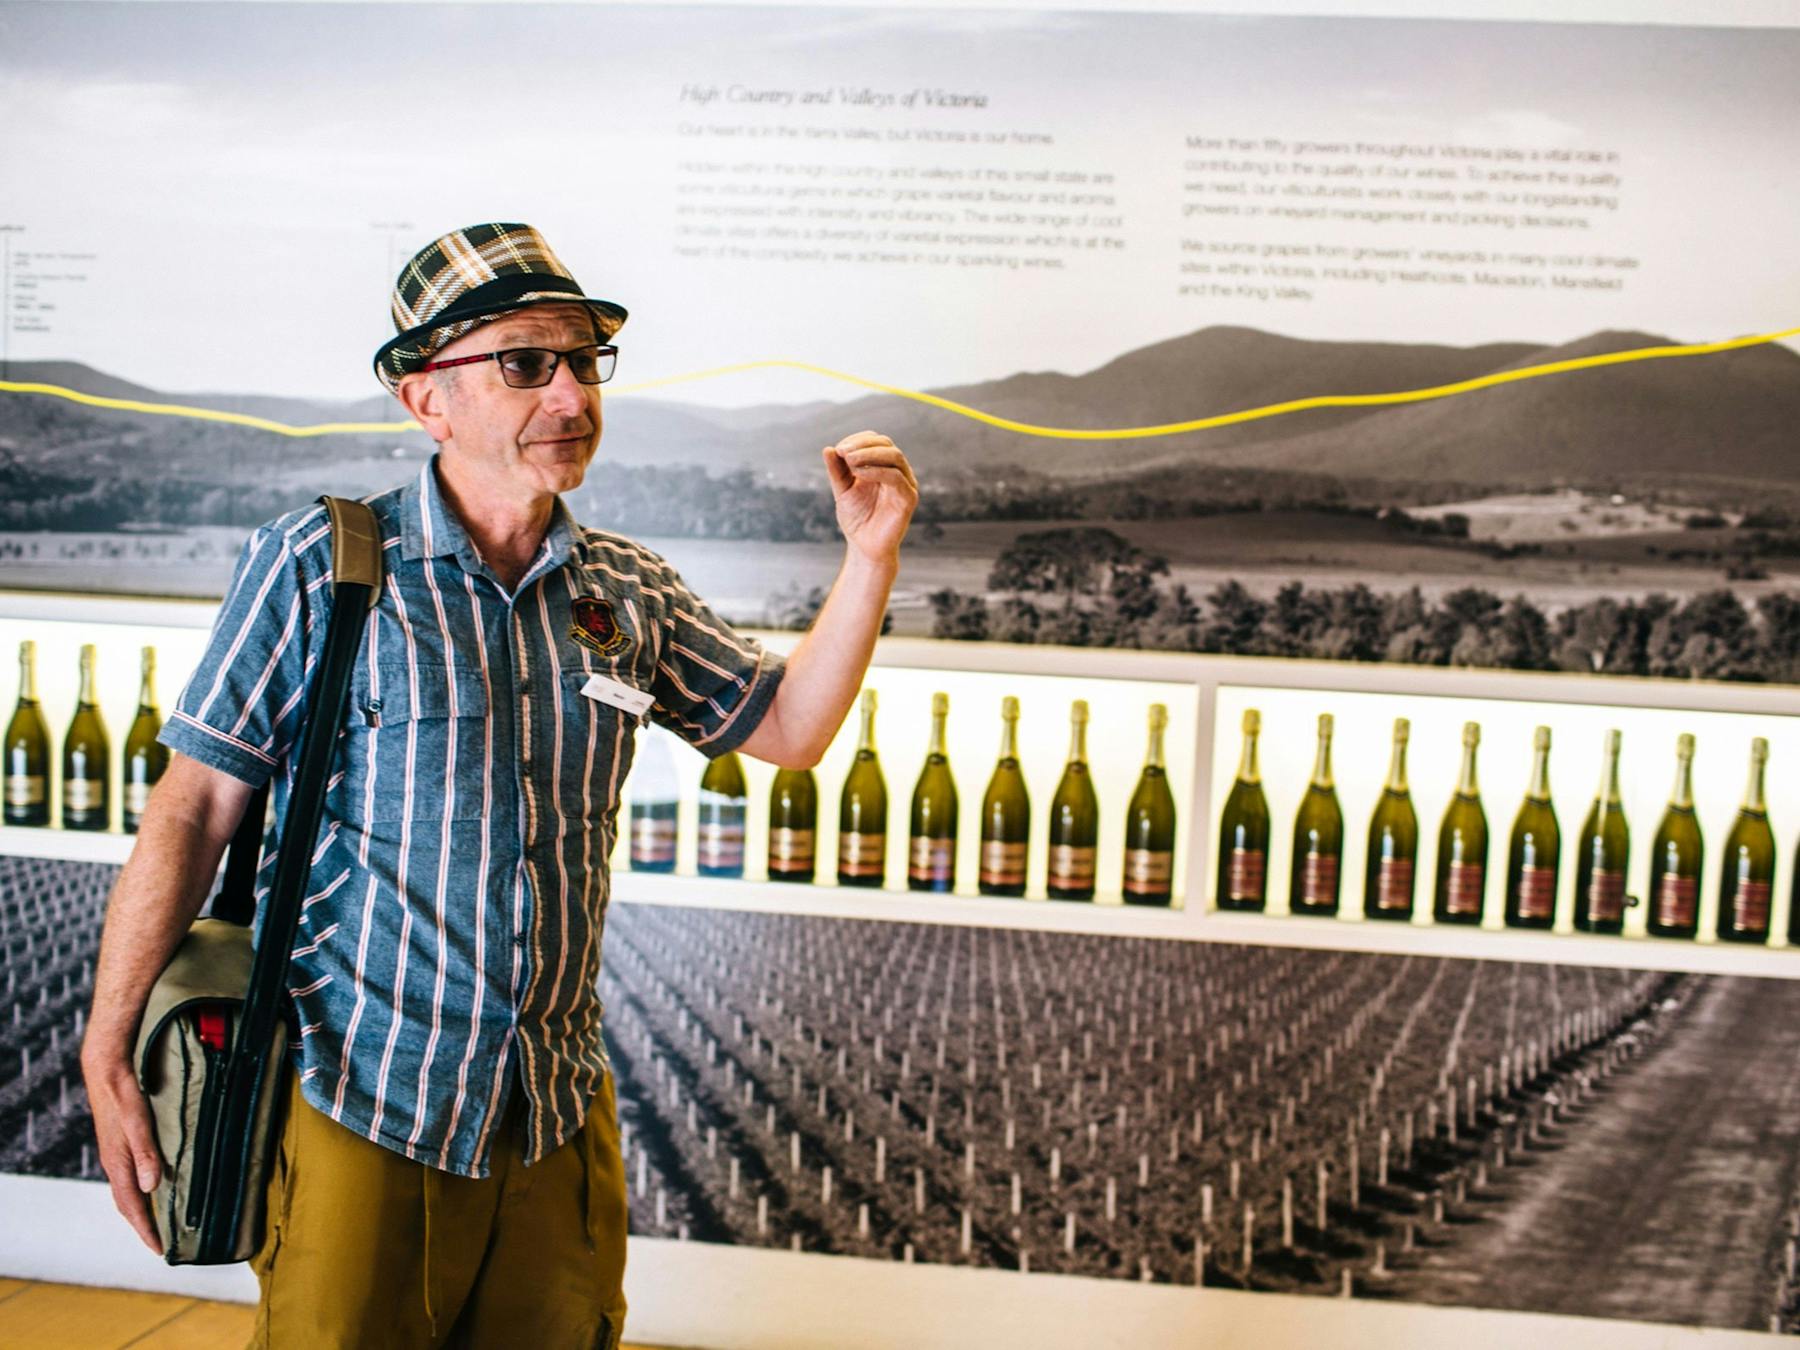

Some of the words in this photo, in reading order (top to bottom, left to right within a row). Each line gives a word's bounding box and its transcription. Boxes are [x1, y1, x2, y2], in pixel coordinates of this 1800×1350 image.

[679, 83, 720, 106] High
[726, 84, 796, 107] Country
[800, 88, 834, 104] and
[839, 88, 896, 109] Valleys
[900, 89, 919, 108] of
[923, 89, 989, 108] Victoria
